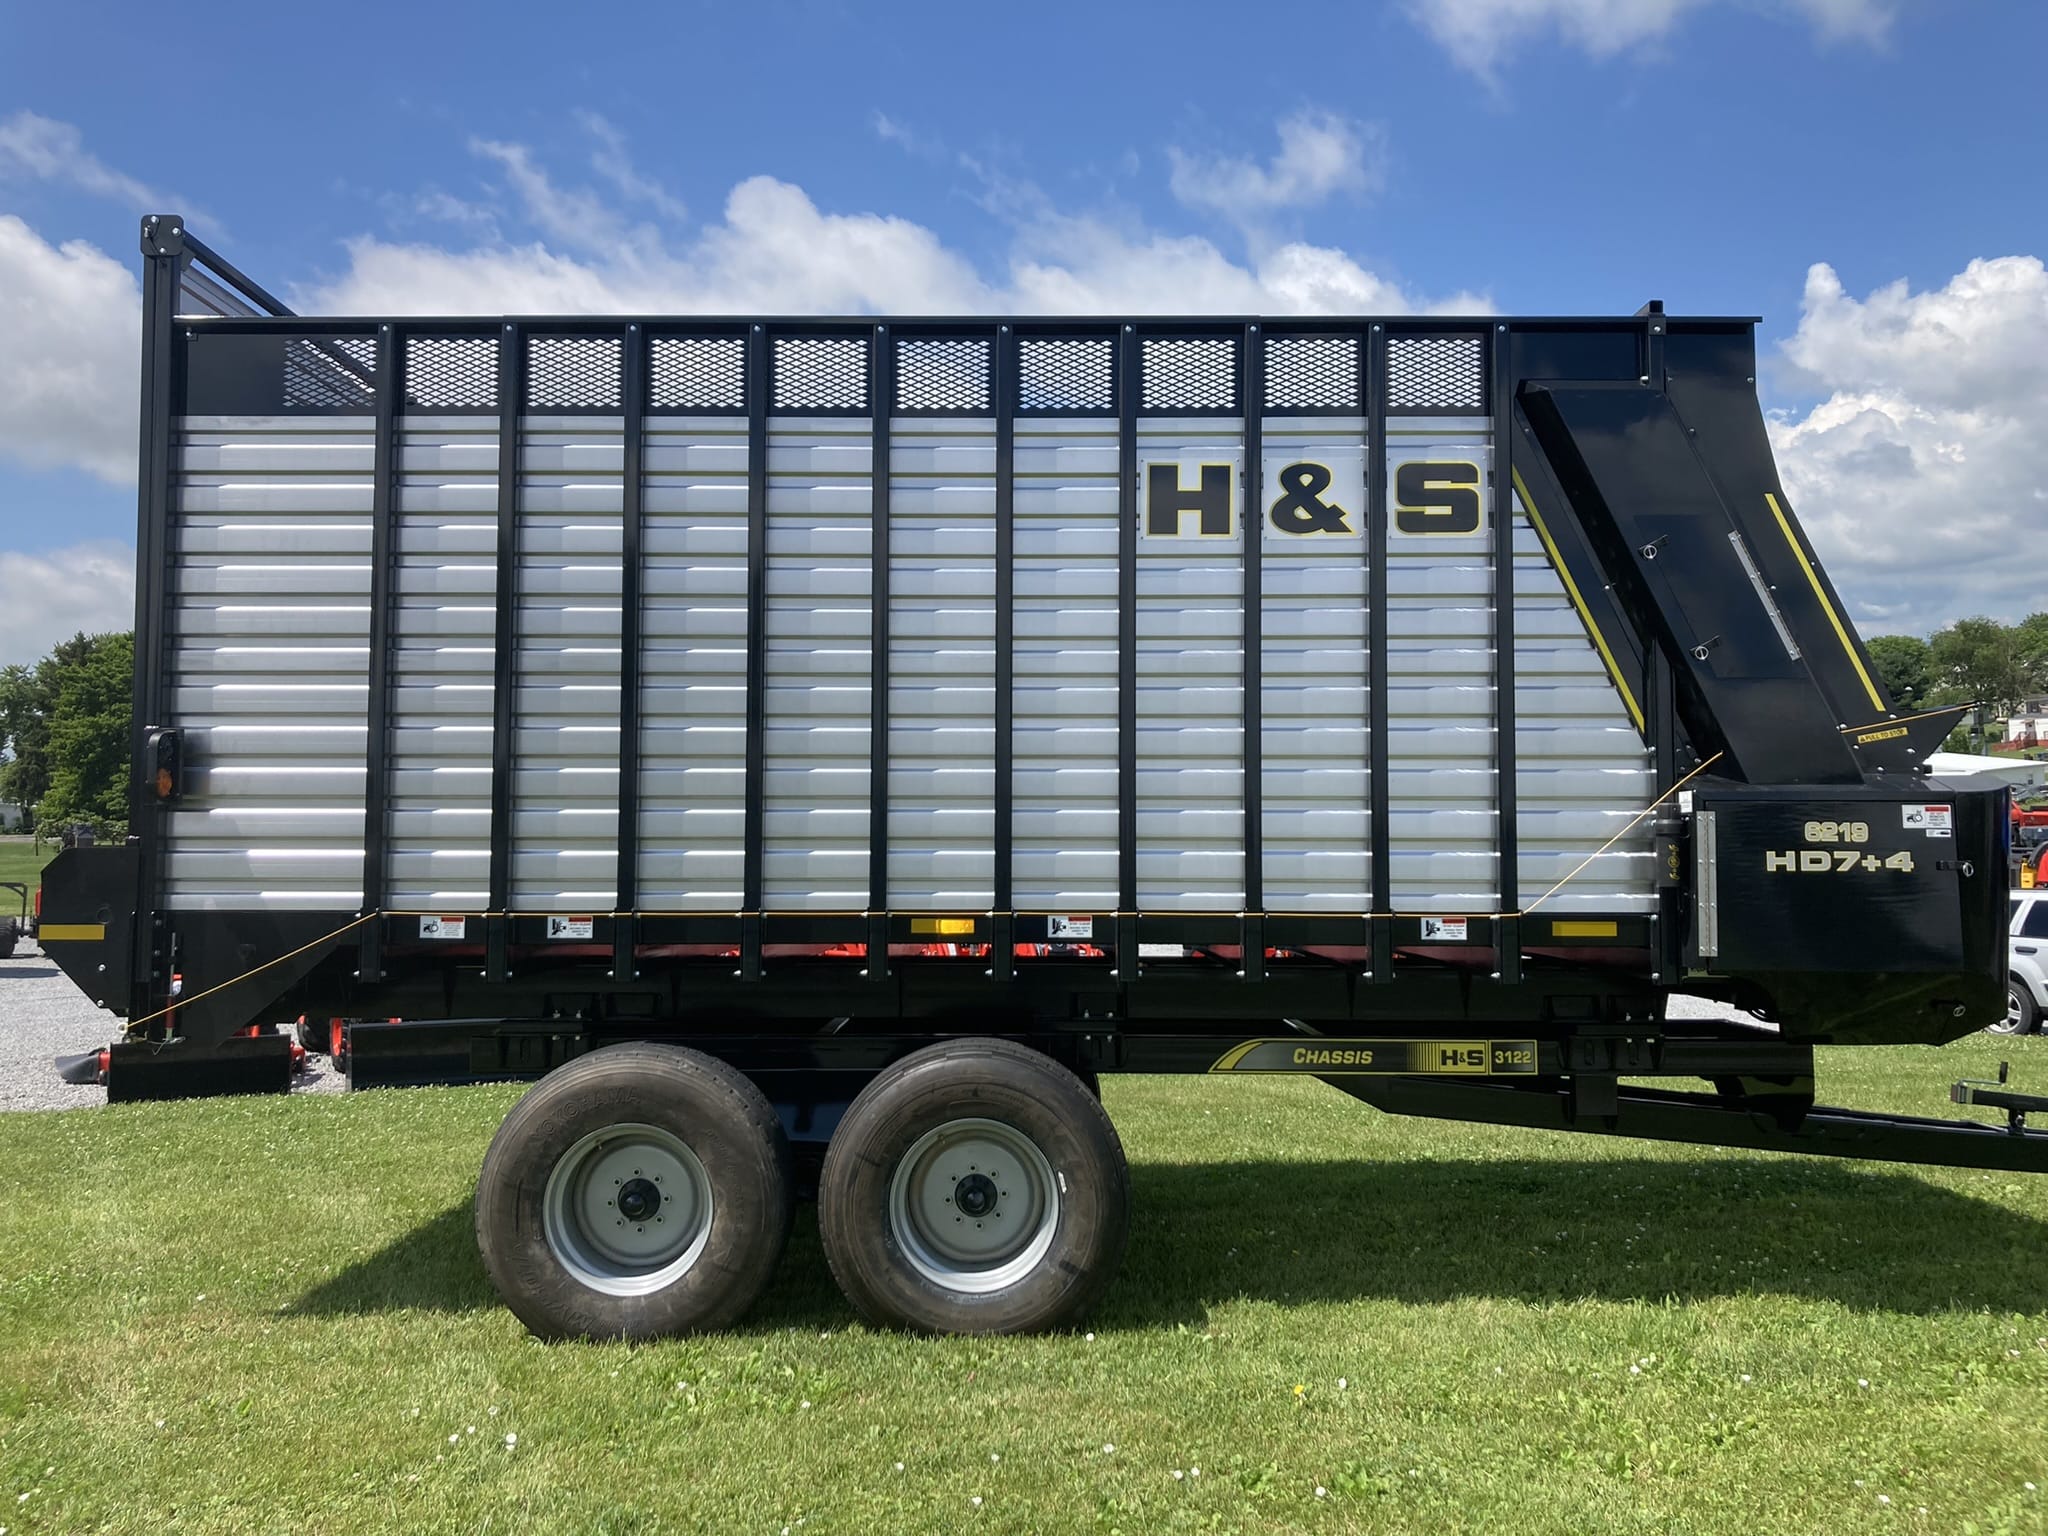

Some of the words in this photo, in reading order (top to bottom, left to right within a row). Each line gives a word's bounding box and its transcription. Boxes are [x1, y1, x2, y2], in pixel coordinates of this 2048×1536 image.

[1804, 821, 1869, 843] 6219
[1766, 850, 1914, 872] HD7+4
[1441, 1049, 1484, 1066] H&S
[1494, 1050, 1532, 1064] 3122
